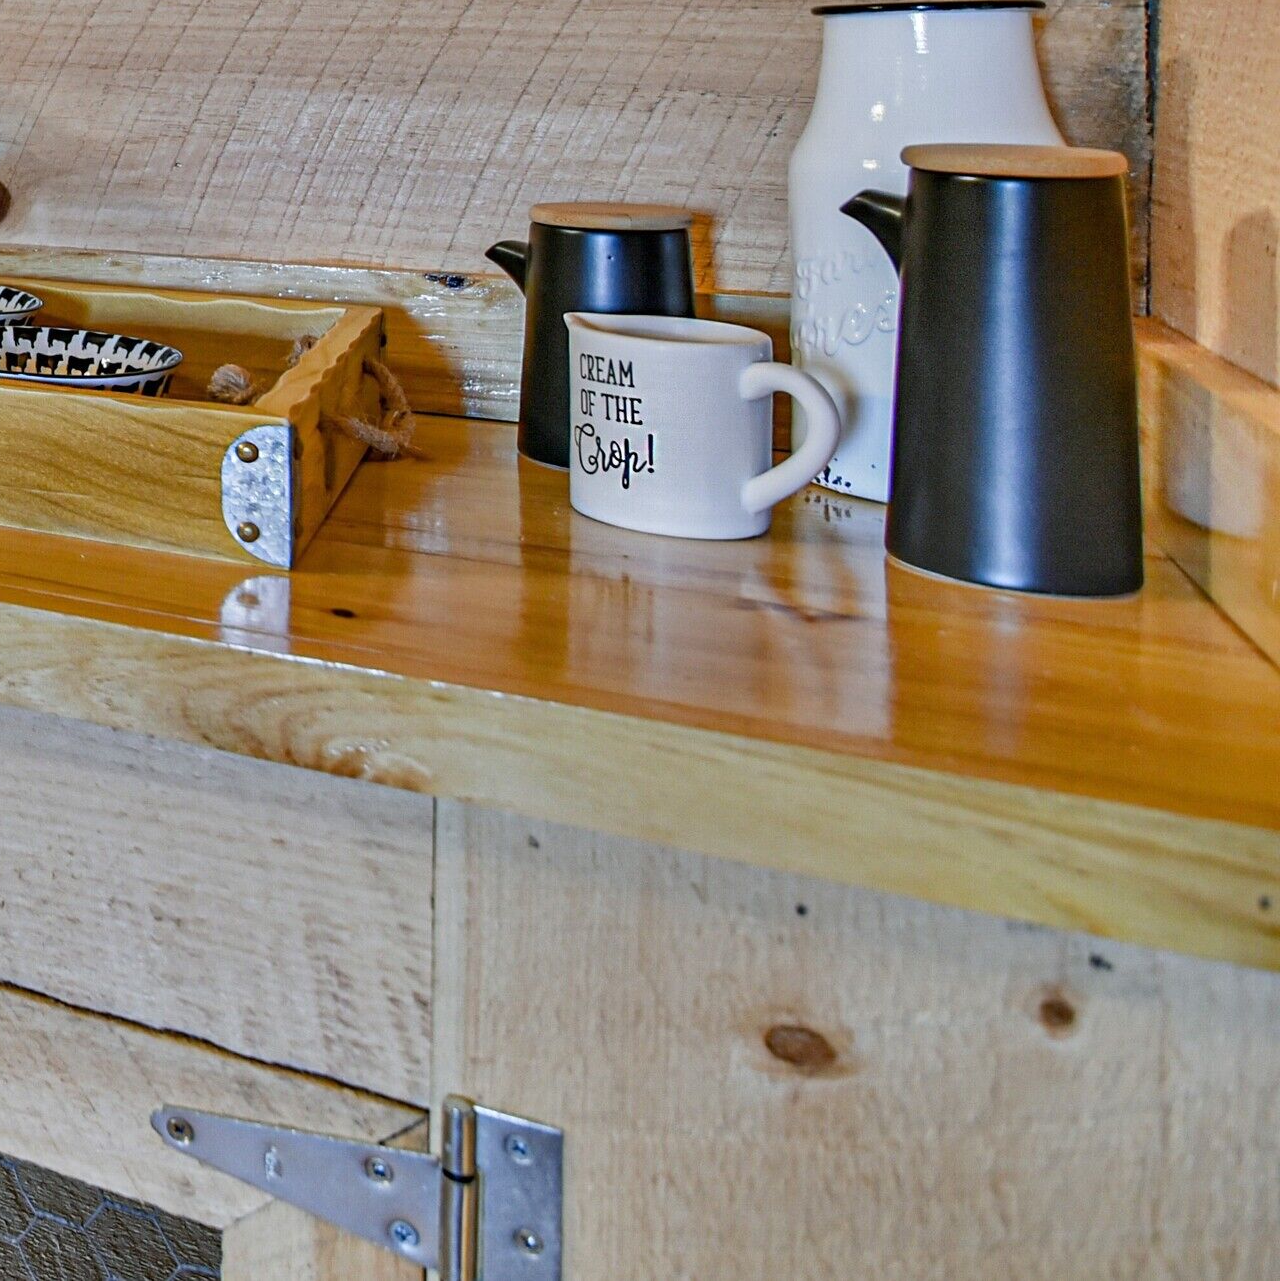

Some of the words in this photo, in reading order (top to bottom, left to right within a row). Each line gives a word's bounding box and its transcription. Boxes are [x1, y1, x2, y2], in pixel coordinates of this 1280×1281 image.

[580, 352, 636, 389] CREAM
[580, 388, 597, 417] OF
[600, 392, 644, 426] THE
[574, 422, 655, 490] Crop!
